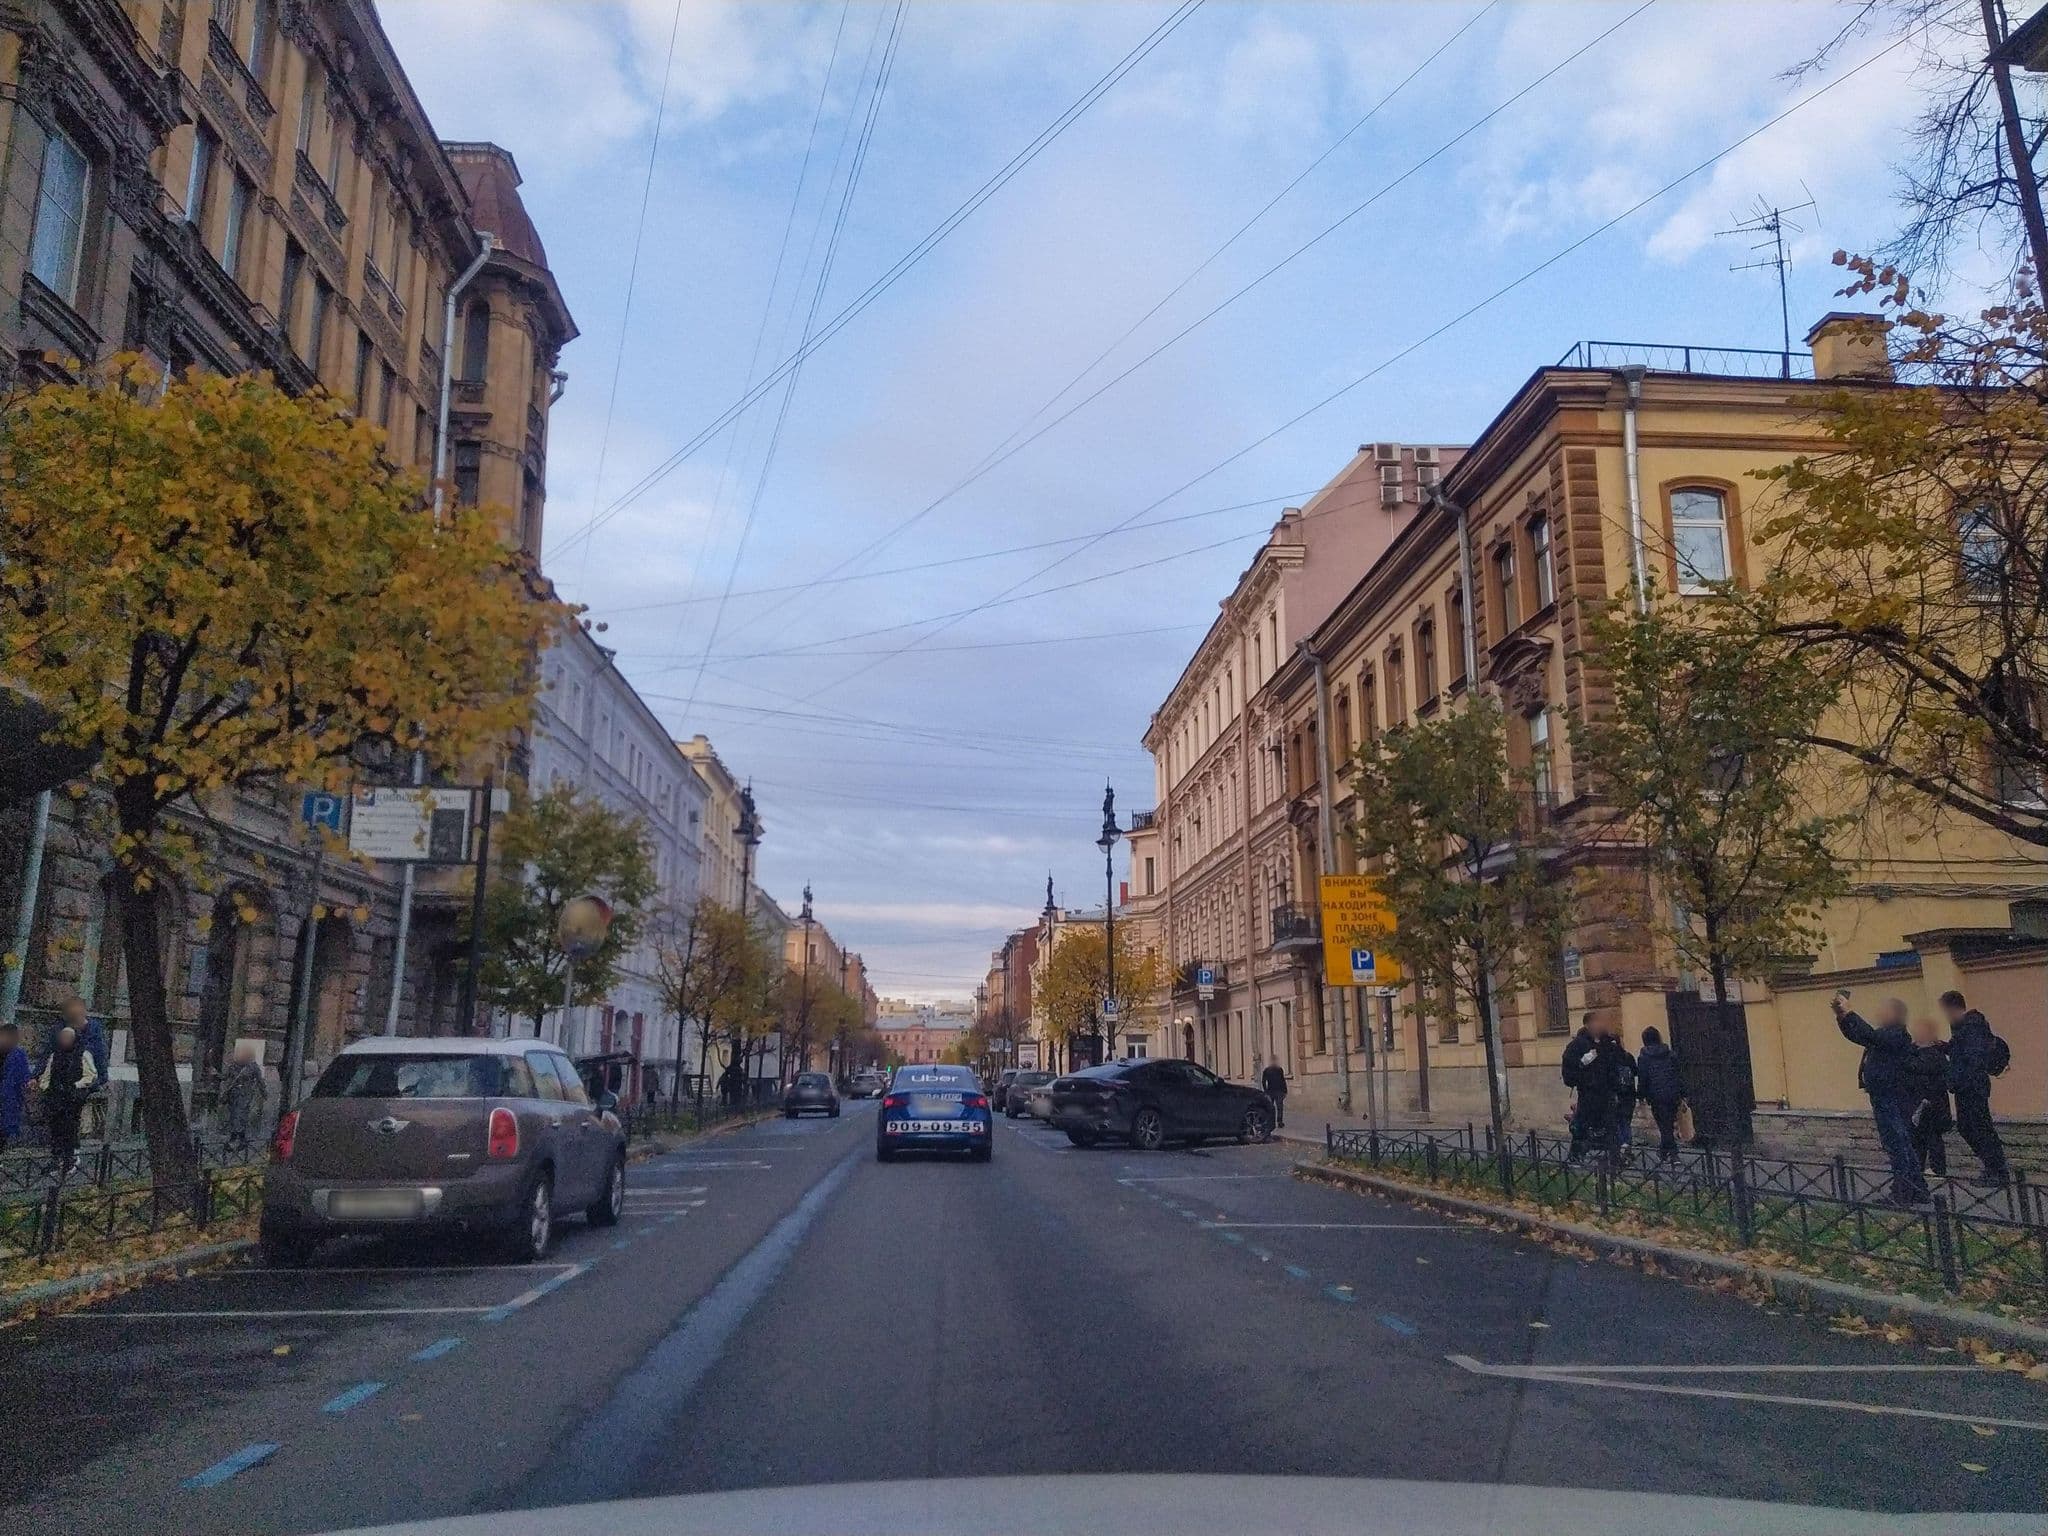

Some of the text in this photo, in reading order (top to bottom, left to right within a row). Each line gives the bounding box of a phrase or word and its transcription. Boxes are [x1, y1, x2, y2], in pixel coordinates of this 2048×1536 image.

[1350, 889, 1366, 898] ВЫ
[1341, 912, 1378, 921] В ЗОНЕ
[1335, 923, 1386, 934] ПЛАТНОЙ
[1356, 950, 1371, 969] P
[889, 1122, 981, 1132] 909-09-55
